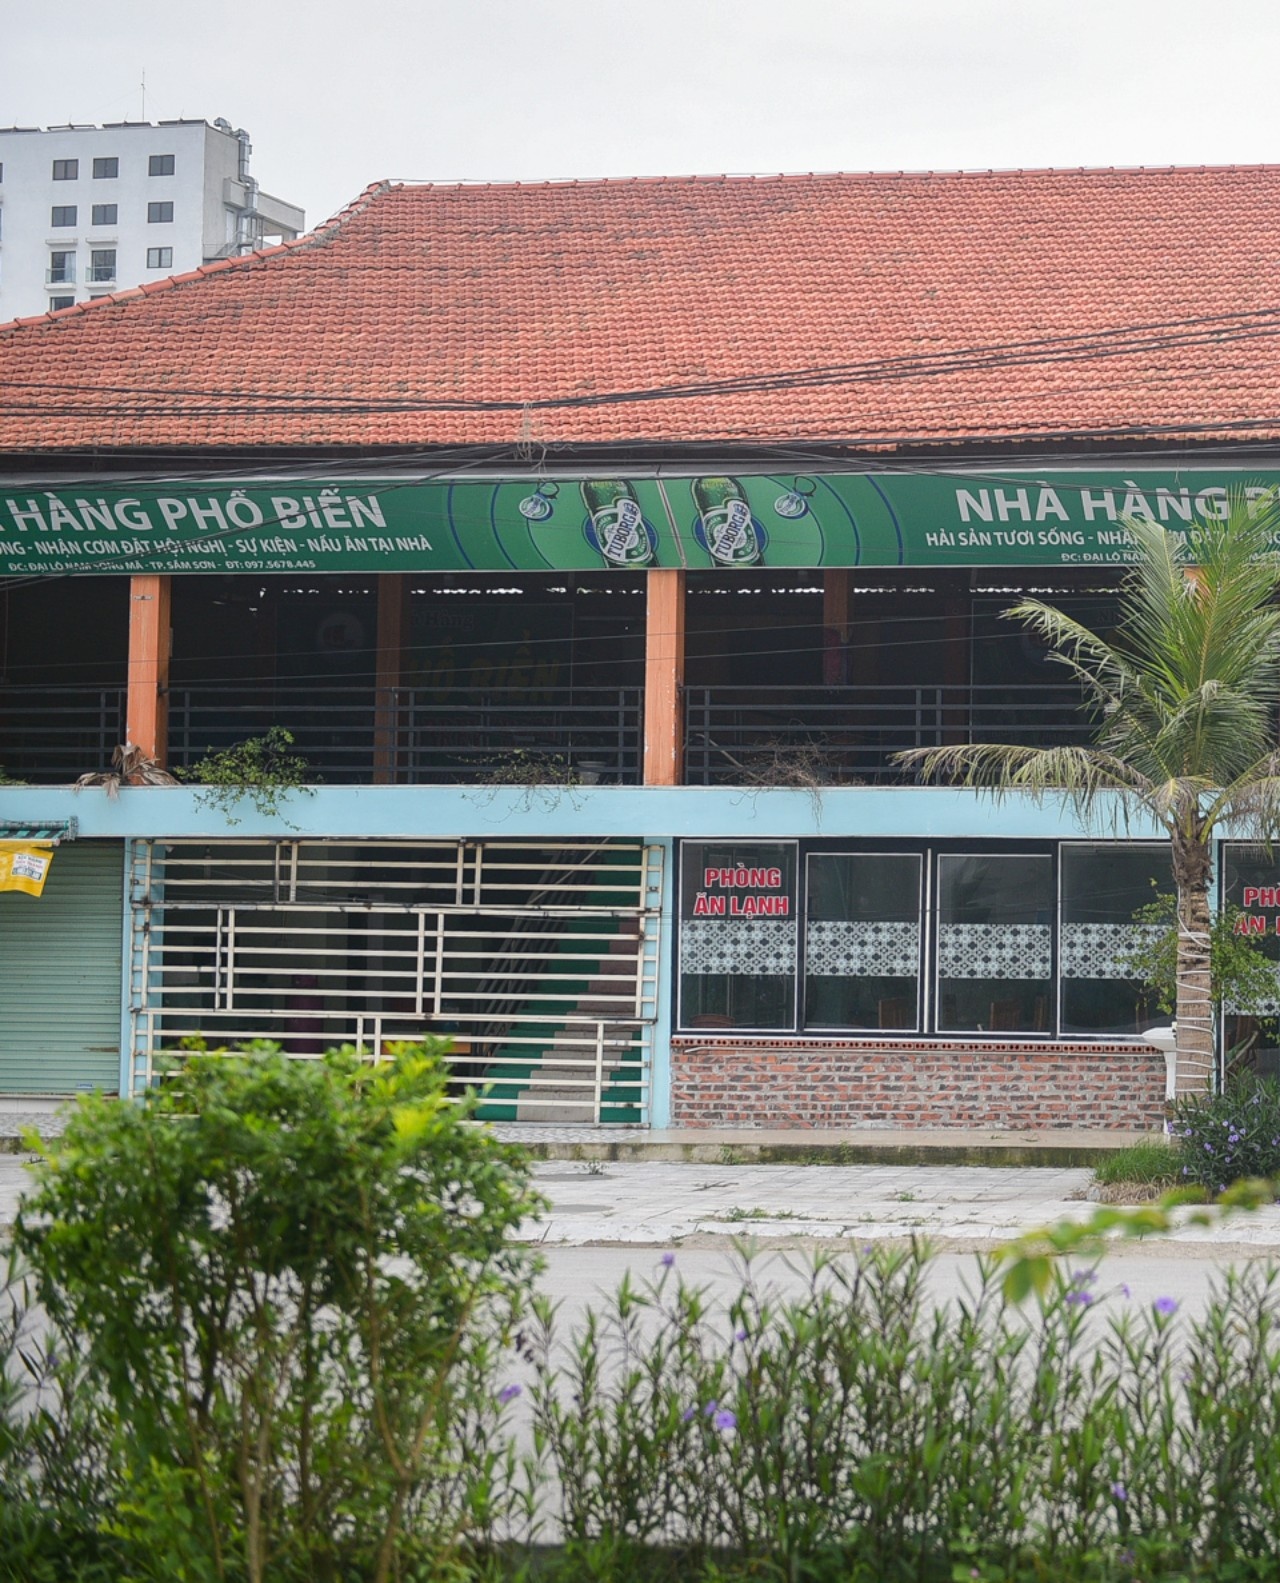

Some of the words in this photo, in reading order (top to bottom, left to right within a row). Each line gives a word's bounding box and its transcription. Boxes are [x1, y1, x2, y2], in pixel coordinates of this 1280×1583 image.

[6, 492, 153, 531] HÀNG
[955, 481, 1070, 521] NHÀ
[1080, 480, 1230, 520] HÀNG
[34, 538, 82, 558] NHẬN
[84, 540, 120, 555] CƠM
[235, 537, 258, 557] SỰ
[260, 536, 298, 556] KIỆN
[307, 534, 342, 552] NẤU
[345, 535, 369, 552] ĂN
[368, 538, 395, 555] TẠI
[395, 534, 433, 551] NHÀ
[608, 513, 637, 558] TUBORG
[715, 513, 746, 557] TUBORG
[926, 528, 956, 546] HẢI
[958, 528, 992, 546] SẢN
[993, 529, 1035, 546] TƯƠI
[1039, 527, 1085, 545] SỐNG
[704, 863, 781, 888] PHÒNG
[693, 892, 725, 916] ĂN
[731, 896, 789, 919] LẠNH
